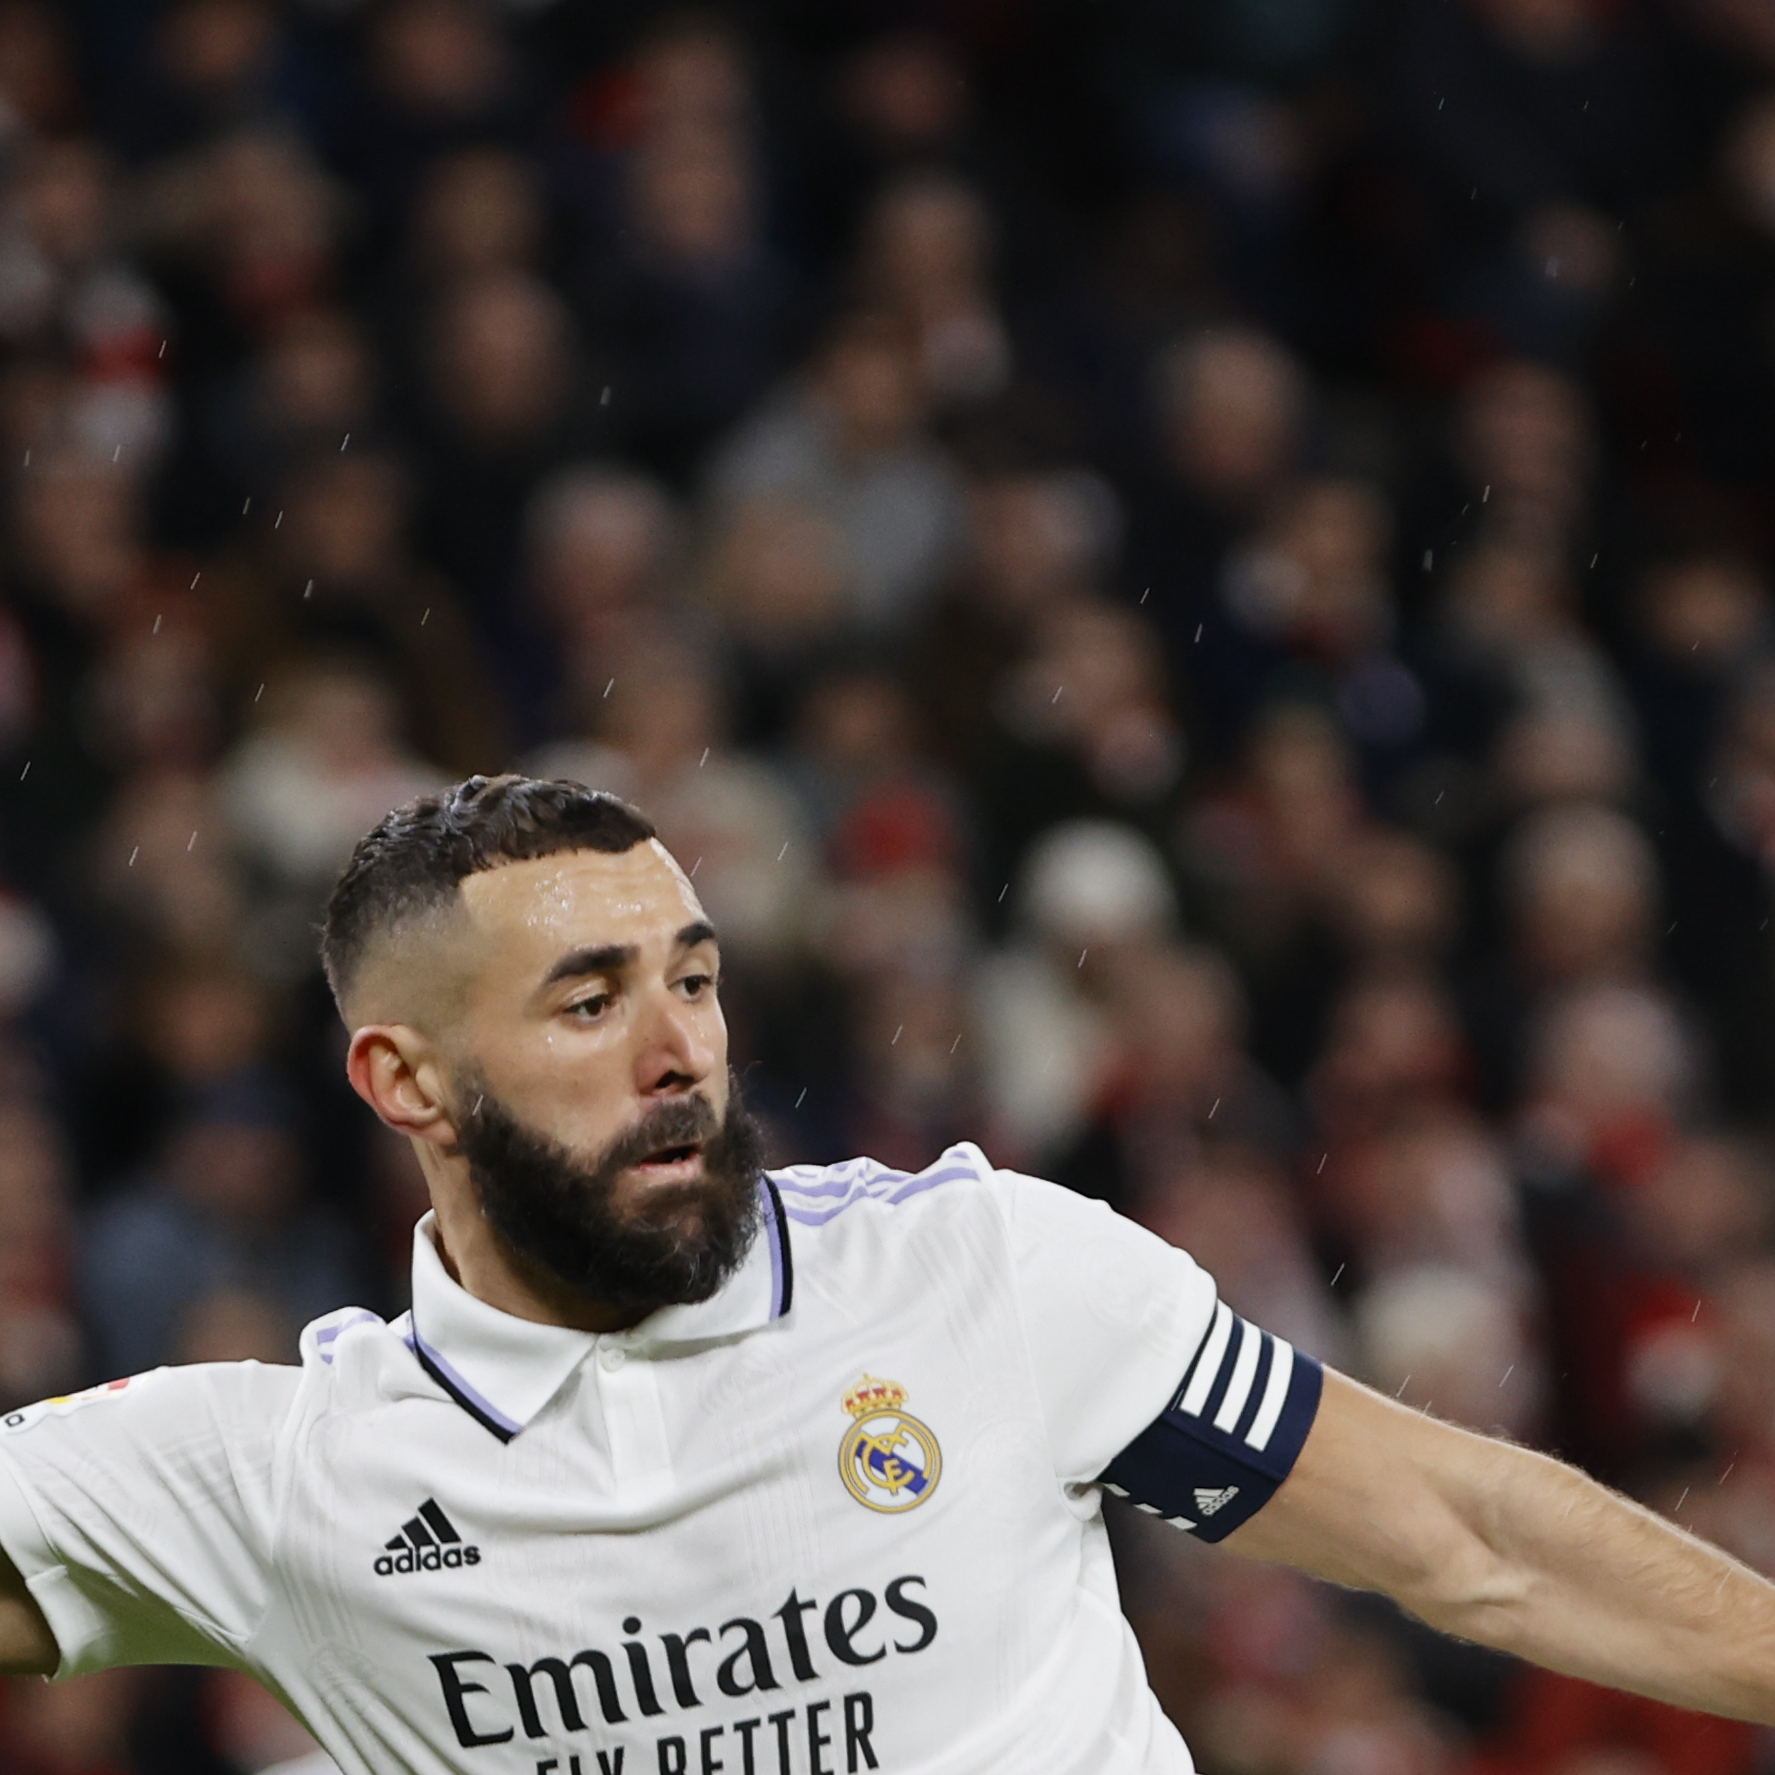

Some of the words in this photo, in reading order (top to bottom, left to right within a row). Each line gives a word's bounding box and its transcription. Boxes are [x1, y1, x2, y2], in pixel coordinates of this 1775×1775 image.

[1201, 1485, 1240, 1516] adidas
[373, 1544, 481, 1576] adidas
[427, 1575, 938, 1748] Emirates
